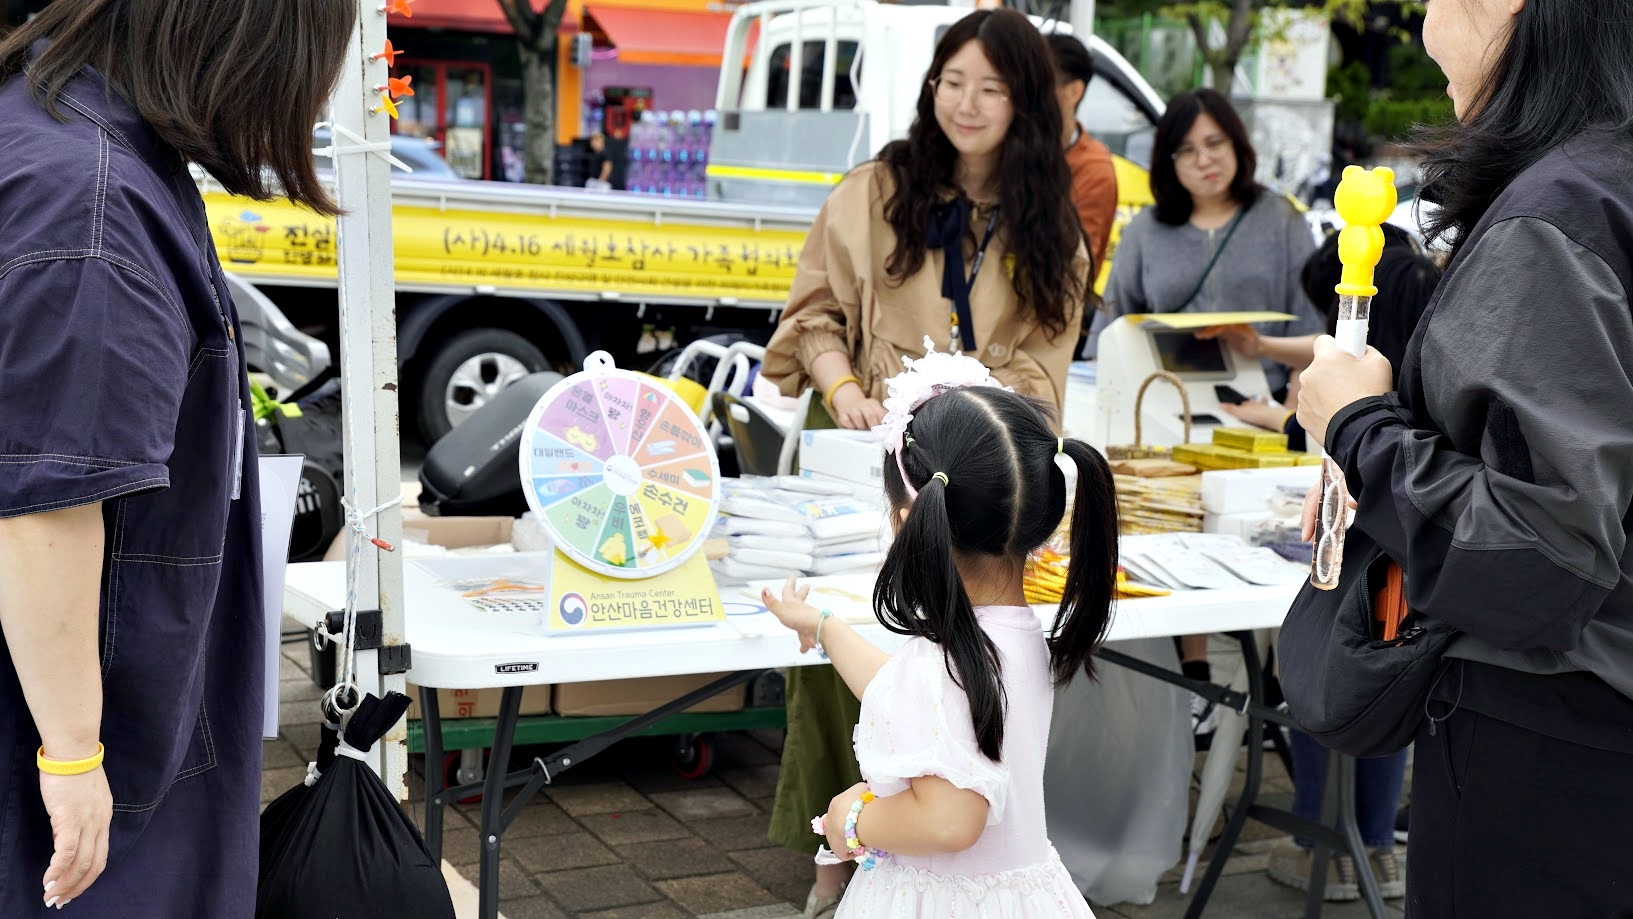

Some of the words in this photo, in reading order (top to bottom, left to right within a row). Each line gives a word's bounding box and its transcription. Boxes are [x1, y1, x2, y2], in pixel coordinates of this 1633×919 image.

[284, 224, 338, 249] 진실
[443, 226, 542, 257] (사)4.16
[551, 231, 678, 271] 세월호참사
[566, 398, 599, 424] 마스크
[603, 392, 634, 412] 아자자!
[607, 406, 622, 421] 꽝
[631, 408, 652, 442] 양우산
[533, 447, 575, 458] 대일밴드
[647, 469, 680, 486] 수세미
[571, 496, 606, 520] 아자자!
[643, 484, 689, 516] 손수건
[575, 513, 591, 530] 꽝
[611, 502, 627, 531] 우비
[629, 502, 648, 540] 에코백
[590, 591, 615, 601] Ansan
[617, 590, 647, 599] Trauma
[649, 588, 675, 598] Center
[590, 597, 714, 622] 안산마음건강센터
[500, 664, 534, 672] LIFETIME
